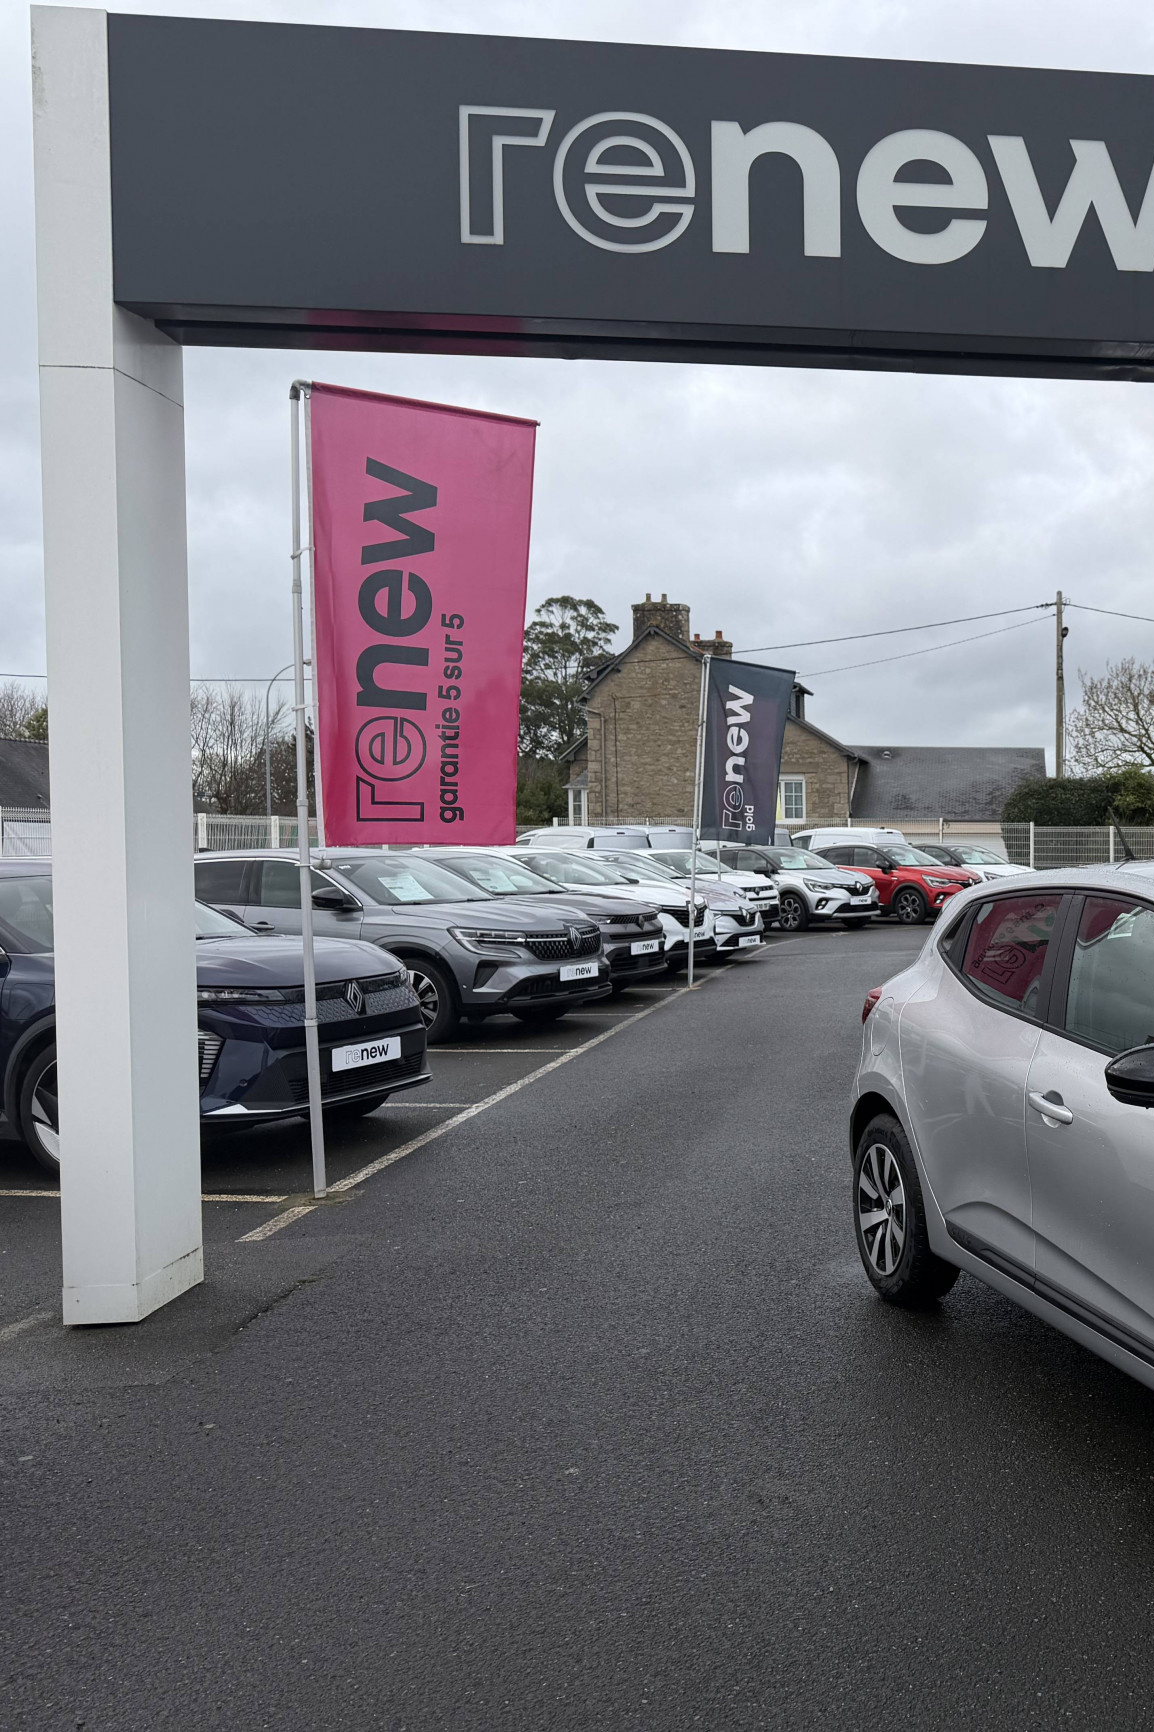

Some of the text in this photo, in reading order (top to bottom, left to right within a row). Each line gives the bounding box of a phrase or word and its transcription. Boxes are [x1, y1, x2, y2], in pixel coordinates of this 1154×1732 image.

[355, 456, 438, 822] renew
[435, 613, 465, 824] garantie 5 sur 5
[722, 684, 754, 831] renew
[744, 805, 755, 832] gold
[345, 1043, 389, 1065] renew
